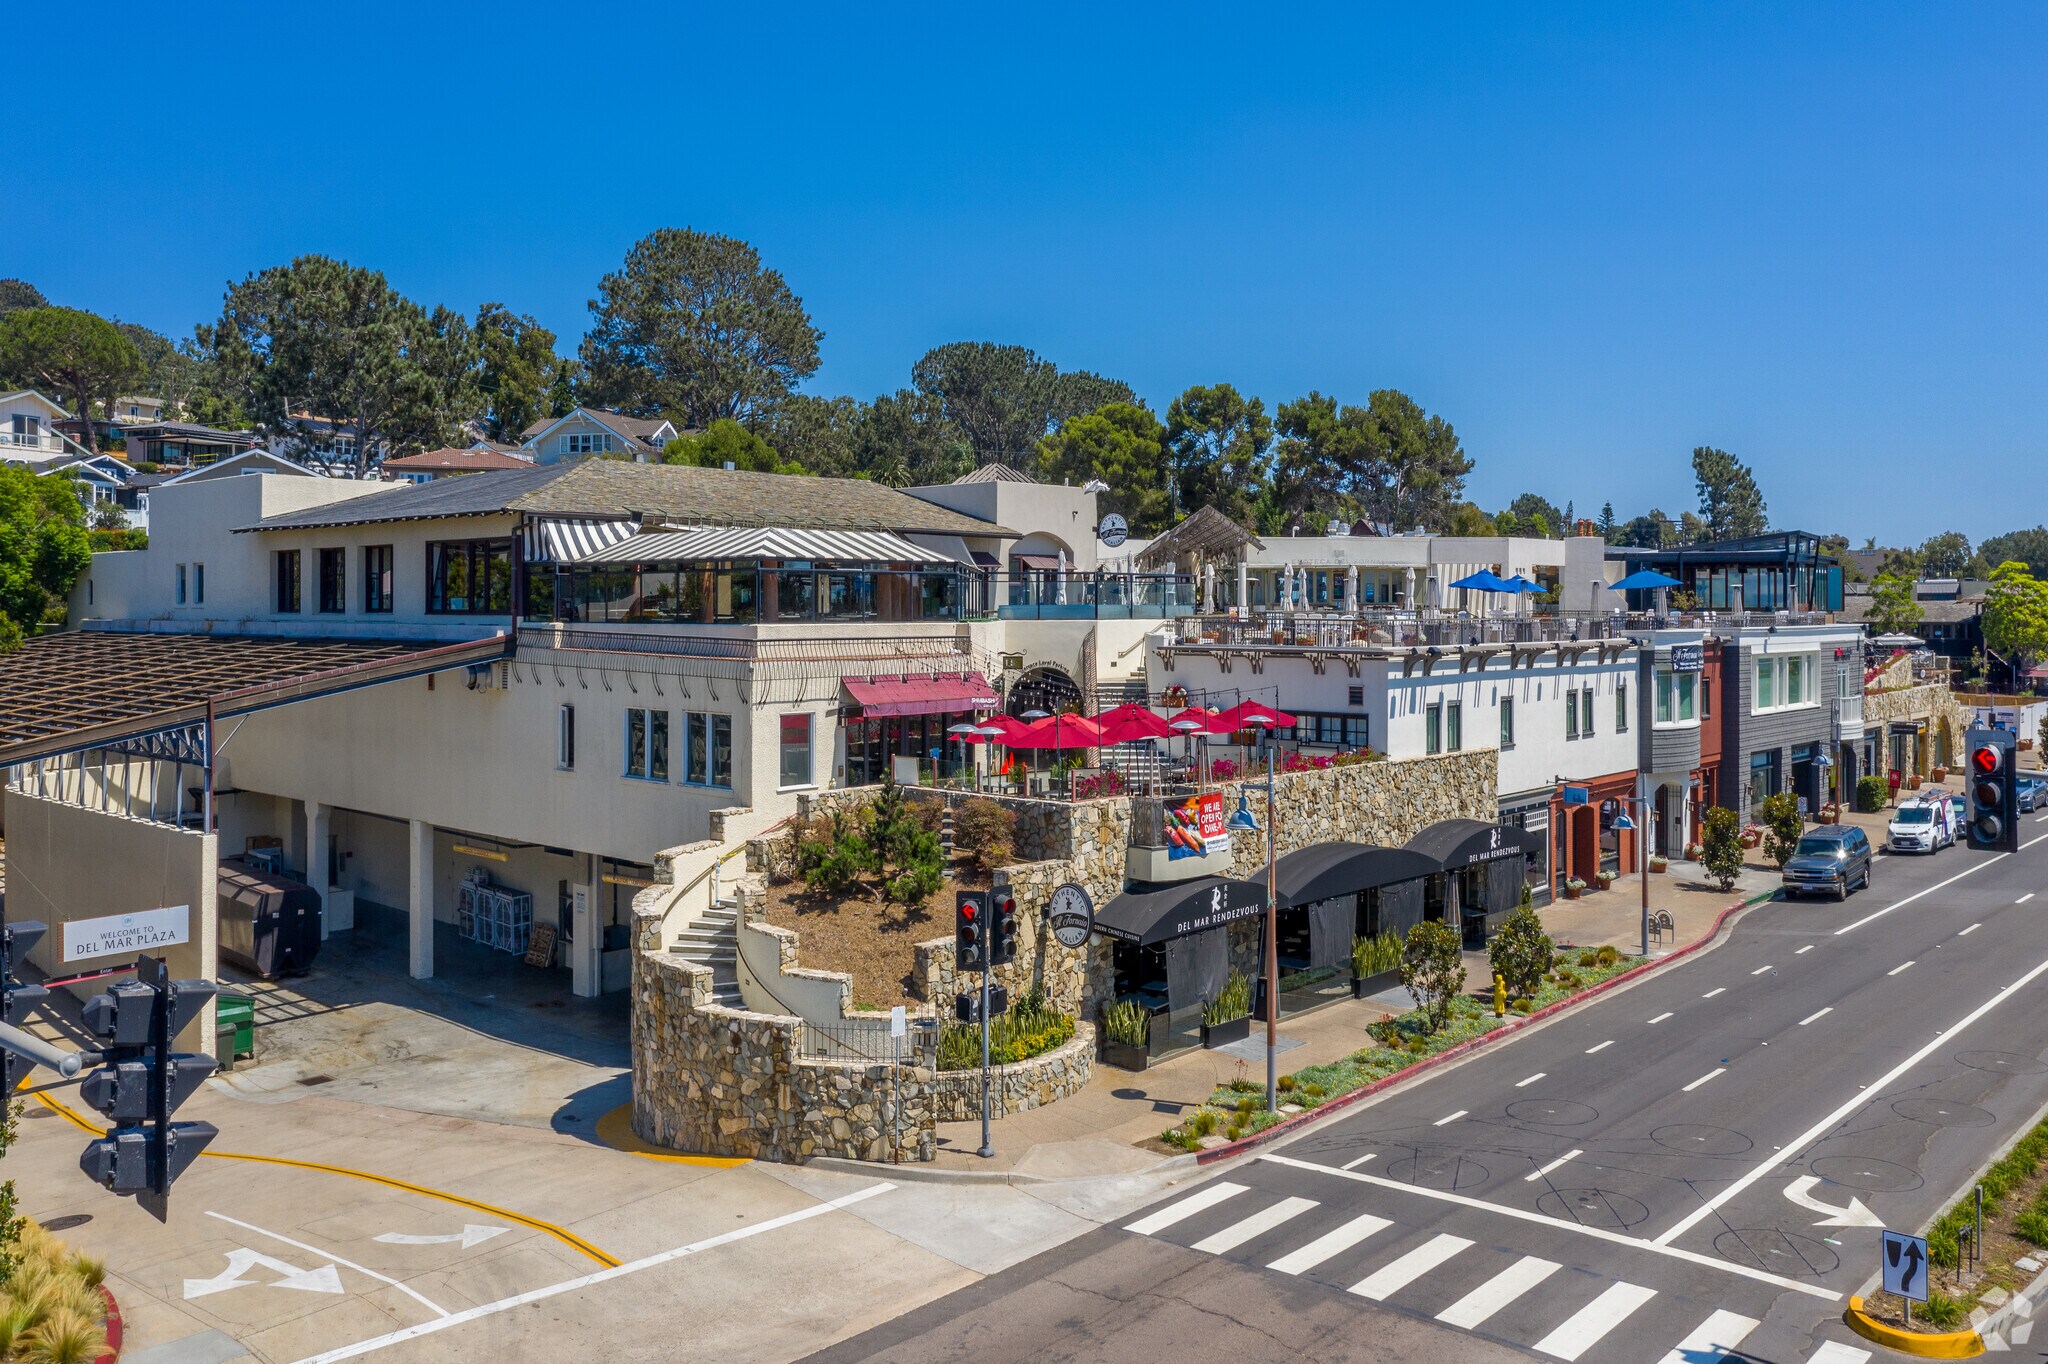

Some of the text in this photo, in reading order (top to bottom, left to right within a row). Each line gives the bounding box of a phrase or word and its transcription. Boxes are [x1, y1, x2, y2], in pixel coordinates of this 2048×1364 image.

[1204, 803, 1212, 813] WE
[1201, 812, 1223, 824] OPEN FO
[1469, 845, 1520, 863] DEL MAR RENDEZVOUS
[1052, 889, 1086, 912] AUTHENTIC
[1062, 913, 1088, 928] Fornaio
[1177, 903, 1259, 933] DEL MAR RENDEZVOUS
[100, 928, 141, 940] WELCOME
[1058, 930, 1084, 943] ITALIAN
[1094, 924, 1140, 942] ODERN CHINESE CUISINE
[76, 930, 176, 955] DEL MAR PLAZA
